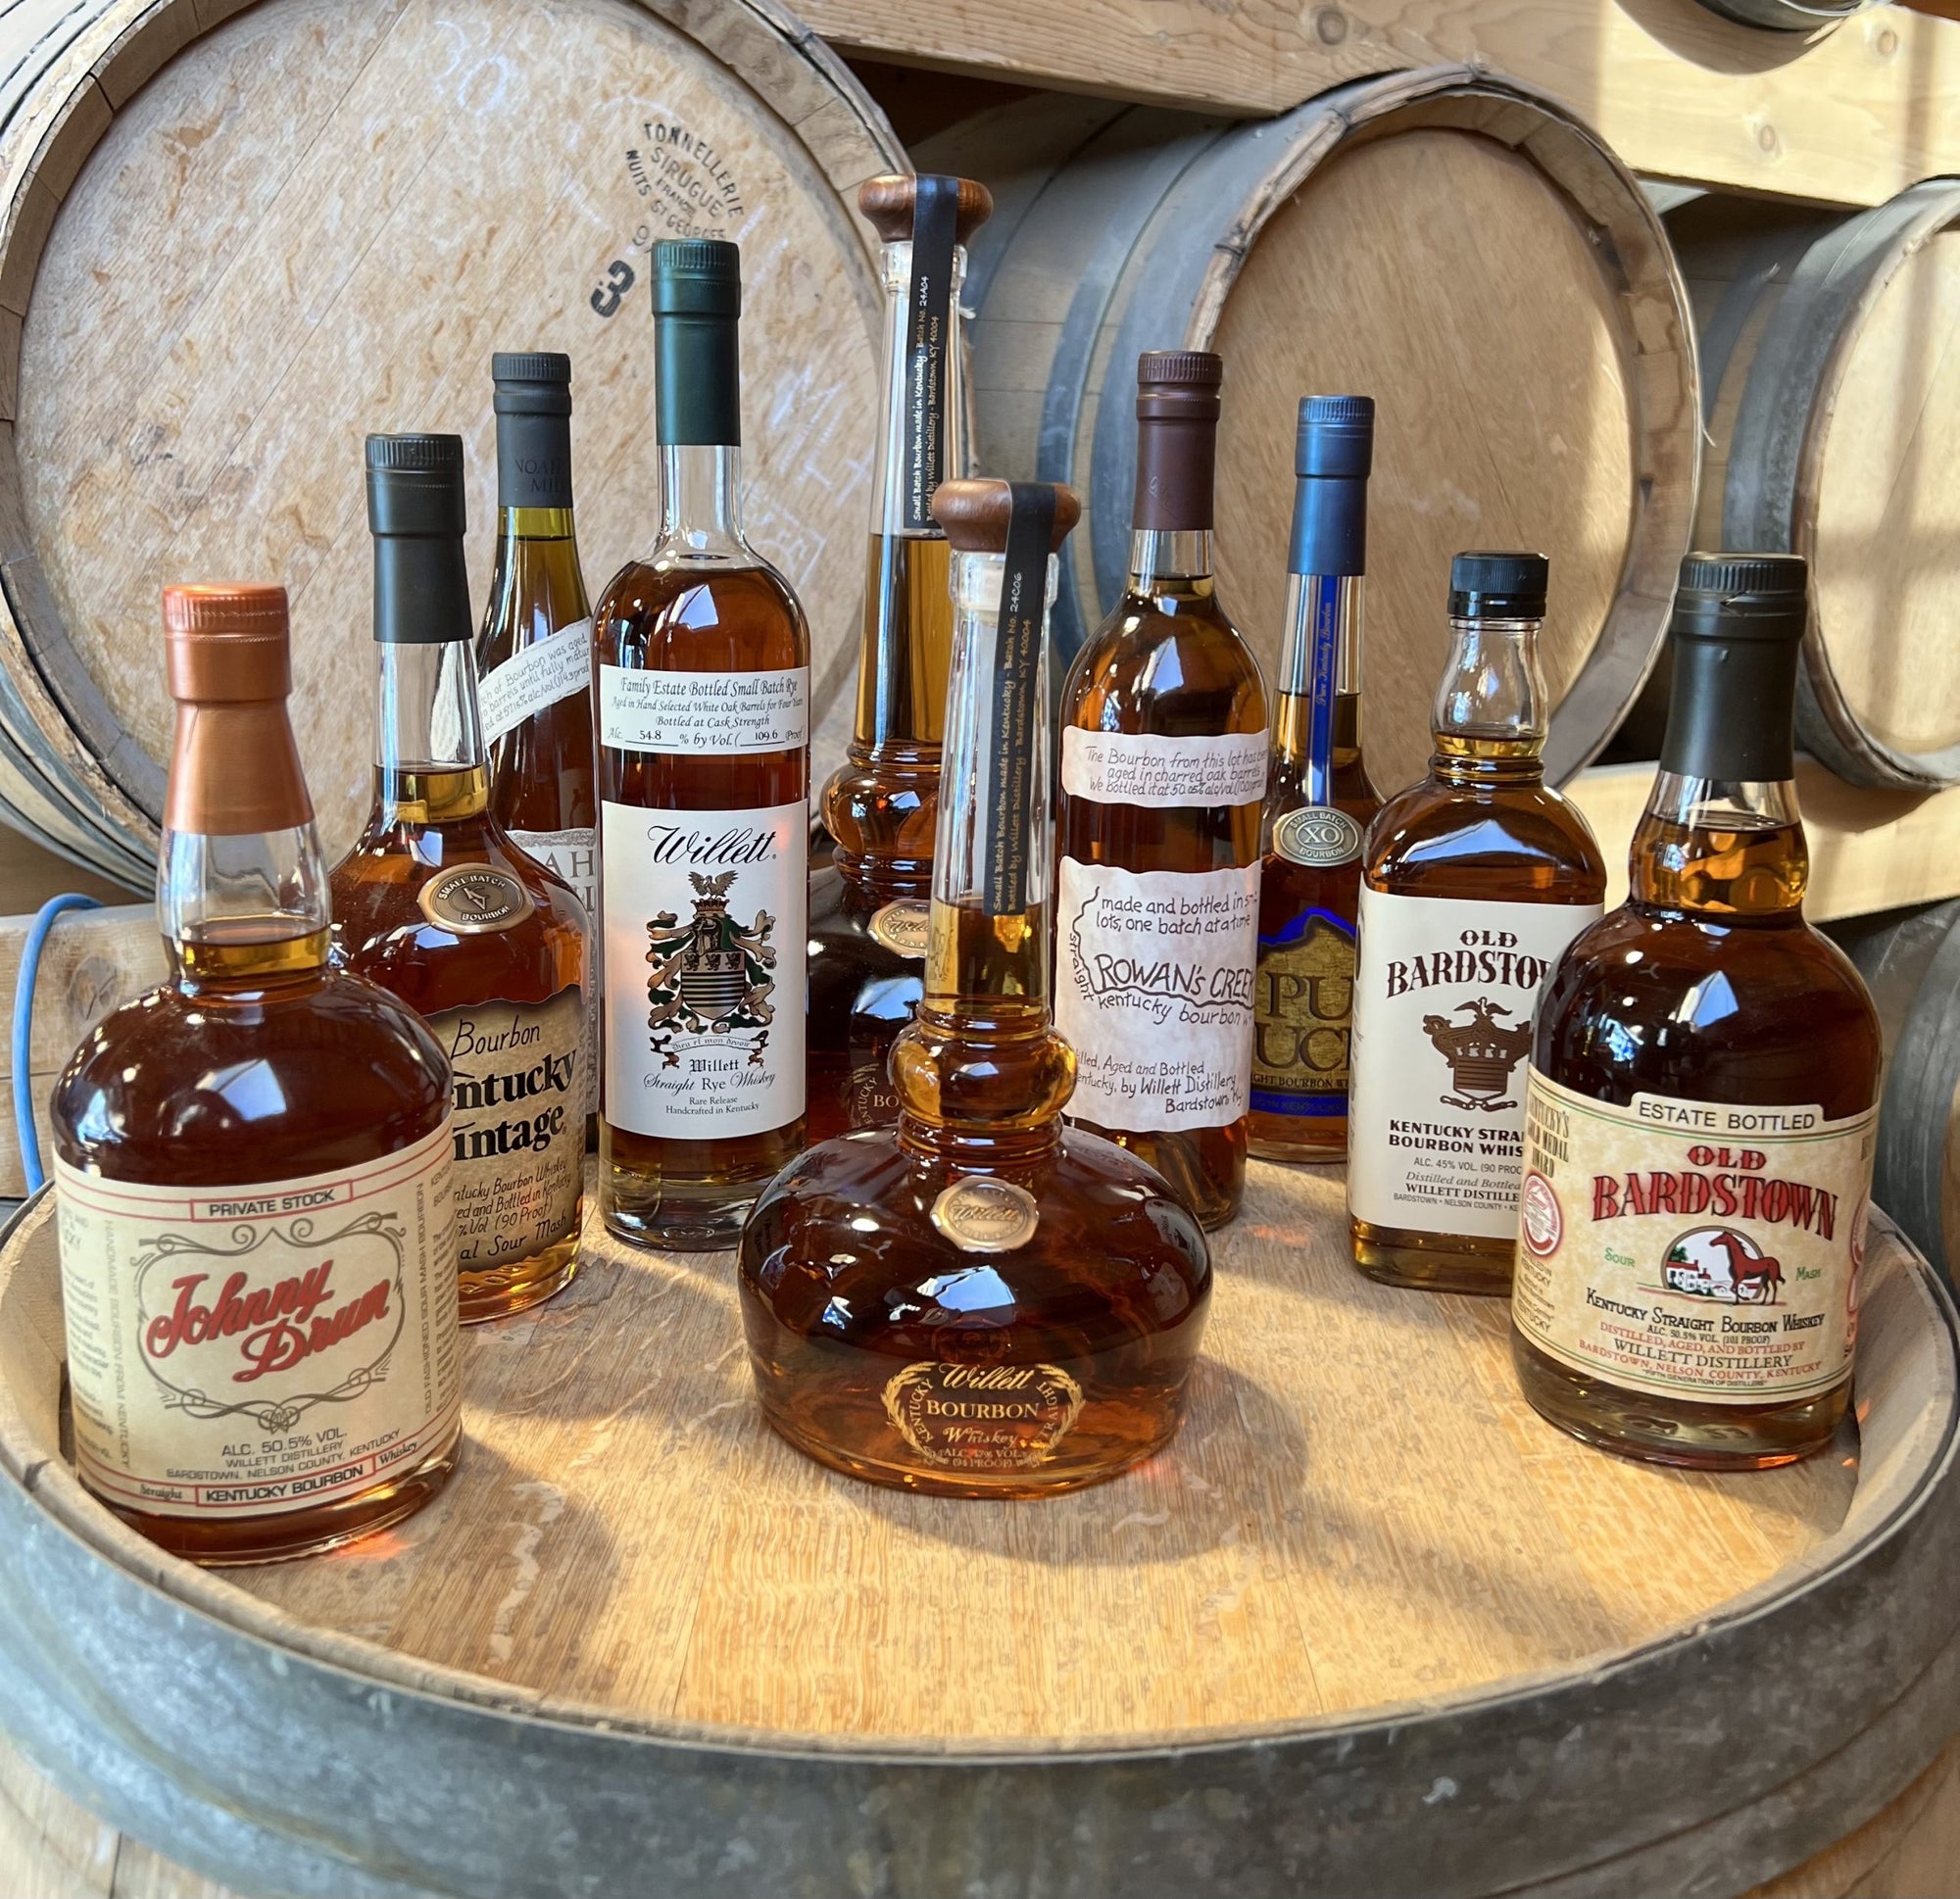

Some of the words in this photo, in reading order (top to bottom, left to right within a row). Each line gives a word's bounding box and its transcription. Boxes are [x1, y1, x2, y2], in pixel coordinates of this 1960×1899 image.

[626, 149, 652, 197] NUITS
[644, 122, 745, 219] TONNELLERIE
[651, 146, 724, 218] SIRUGUE
[918, 275, 929, 307] 24A04
[914, 356, 928, 398] Kentucky
[1008, 572, 1022, 612] 24C06
[506, 656, 546, 686] Bourbon
[548, 645, 566, 660] was
[568, 633, 587, 654] aged
[621, 677, 651, 698] Family
[653, 680, 686, 696] Estate
[689, 680, 728, 697] Bottled
[731, 678, 759, 697] Small
[760, 677, 784, 696] Batch
[636, 698, 657, 711] Hand
[658, 701, 691, 712] Selected
[693, 701, 718, 712] White
[720, 701, 738, 714] Oak
[740, 700, 765, 712] Barrels
[1000, 680, 1014, 740] Kentucky
[656, 715, 691, 727] Bottled
[694, 717, 705, 727] at
[708, 716, 731, 730] Cask
[732, 716, 770, 730] Strength
[639, 729, 662, 741] 54.8
[693, 732, 707, 749] by
[754, 729, 778, 742] 109.6
[1085, 746, 1103, 763] The
[1107, 748, 1165, 768] Bourbon
[1169, 752, 1200, 769] from
[1202, 750, 1224, 768] this
[1089, 777, 1104, 792] We
[1106, 778, 1146, 796] bottled
[1107, 767, 1136, 785] aged
[1154, 767, 1203, 783] charred
[1206, 767, 1226, 782] oak
[995, 791, 1006, 839] Bourbon
[1290, 812, 1318, 829] SMALL
[1319, 811, 1348, 830] BATCH
[648, 825, 776, 864] Willett
[1303, 827, 1341, 844] XO
[994, 841, 1005, 874] Batch
[1298, 847, 1345, 858] BOURBON
[438, 877, 467, 900] SMALL
[469, 875, 506, 889] BATCH
[993, 876, 1004, 911] Small
[1006, 871, 1019, 912] Bottled
[462, 905, 510, 921] BOURBON
[1102, 895, 1142, 913] made
[1146, 896, 1176, 915] and
[1180, 894, 1230, 915] bottled
[1097, 911, 1122, 932] lots,
[1126, 919, 1152, 932] one
[1158, 917, 1201, 935] batch
[1459, 929, 1518, 949] OLD
[1069, 933, 1095, 1001] straight
[1386, 950, 1552, 998] BARDSTO
[1098, 993, 1172, 1025] kentucky
[1179, 1003, 1241, 1026] bourbon
[451, 1015, 540, 1060] Bourbon
[452, 1048, 576, 1110] ntucky
[689, 1059, 739, 1075] Willett
[1102, 1054, 1133, 1077] Aged
[1136, 1061, 1157, 1076] and
[1159, 1060, 1204, 1077] Bottled
[644, 1073, 695, 1096] Straight
[702, 1078, 726, 1093] Rye
[730, 1067, 775, 1090] Whiskey
[1121, 1078, 1136, 1098] by
[1140, 1077, 1182, 1096] Willett
[1184, 1071, 1237, 1094] Distillery
[666, 1105, 713, 1115] Handcrafted
[725, 1101, 760, 1114] Kentucky
[689, 1096, 708, 1105] Rare
[710, 1096, 738, 1104] Release
[1390, 1119, 1474, 1139] KENTUCKY
[1639, 1100, 1716, 1127] ESTATE
[1728, 1113, 1815, 1131] BOTTLED
[1389, 1134, 1474, 1153] BOURBON
[1687, 1144, 1768, 1171] OLD
[1405, 1171, 1453, 1185] Distilled
[1456, 1178, 1478, 1187] and
[1413, 1157, 1433, 1167] ALC.
[1436, 1159, 1455, 1170] 45%
[1458, 1161, 1478, 1172] VOL.
[1481, 1162, 1495, 1173] (90
[493, 1173, 533, 1195] Bourbon
[1405, 1183, 1461, 1197] WILLETT
[210, 1199, 277, 1217] PRIVATE
[282, 1189, 335, 1211] STOCK
[470, 1217, 488, 1234] Vol
[495, 1212, 517, 1230] (90
[519, 1195, 553, 1224] Proof)
[473, 1199, 493, 1217] and
[495, 1188, 531, 1213] Bottled
[1394, 1193, 1438, 1204] BARDSTOWN
[1444, 1198, 1472, 1208] NELSON
[1473, 1201, 1502, 1210] COUNTY
[1592, 1171, 1838, 1242] BARDSTOWN
[488, 1235, 527, 1255] Sour
[535, 1209, 566, 1241] Mash
[1603, 1246, 1636, 1268] SOUR
[147, 1259, 334, 1358] Johnny
[1586, 1288, 1648, 1322] KENTUCKY
[1651, 1306, 1715, 1332] STRAIGHT
[1721, 1315, 1778, 1334] BOURBON
[1783, 1313, 1826, 1332] WHISKEY
[232, 1279, 391, 1383] Drum
[1600, 1321, 1666, 1347] DISTILLED,
[1668, 1338, 1705, 1354] AGED,
[1707, 1342, 1735, 1356] AND
[1738, 1342, 1789, 1356] BOTTLED
[1646, 1325, 1668, 1337] ALC.
[1670, 1329, 1696, 1340] 50.5%
[1699, 1333, 1718, 1343] VOL.
[1740, 1335, 1770, 1345] PROOF)
[1579, 1339, 1653, 1371] BARDSTOWN,
[1656, 1361, 1703, 1377] NELSON
[1709, 1368, 1763, 1381] COUNTY,
[1766, 1360, 1822, 1379] KENTUCKY
[1613, 1338, 1692, 1365] WILLETT
[1696, 1354, 1792, 1370] DISTILLERY
[939, 1362, 1035, 1390] Willett
[909, 1378, 933, 1443] KENTUCKY
[926, 1400, 1039, 1419] BOURBON
[221, 1443, 255, 1457] ALC.
[261, 1435, 313, 1455] 50.5%
[317, 1427, 347, 1443] VOL.
[942, 1427, 1017, 1450] Whiskey
[225, 1454, 276, 1468] WILLETT
[281, 1441, 343, 1463] DISTILLERY
[247, 1463, 294, 1478] NELSON
[349, 1429, 400, 1457] KENTUCKY
[140, 1482, 182, 1500] Straight
[206, 1484, 287, 1502] KENTUCKY
[292, 1465, 364, 1494] BOURBON
[379, 1440, 418, 1465] Whiskey
